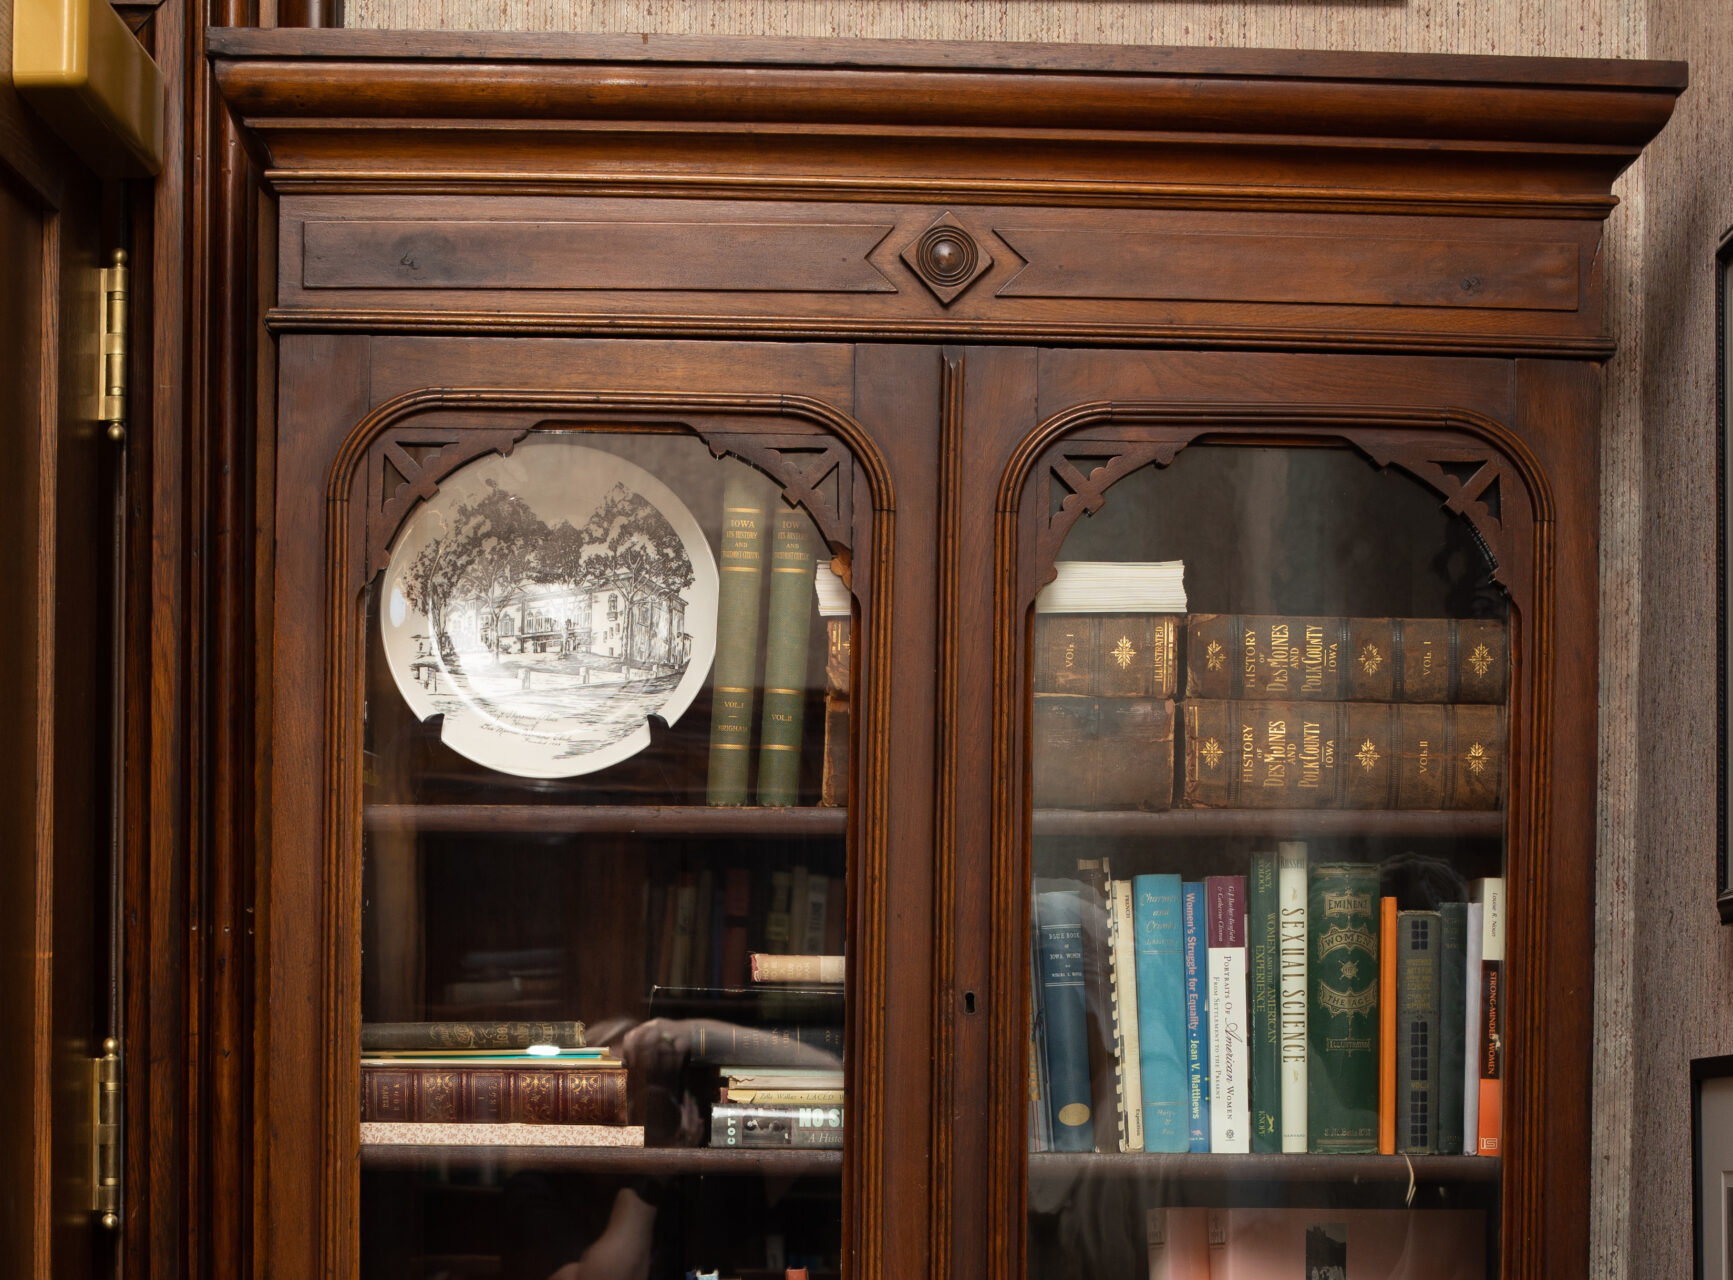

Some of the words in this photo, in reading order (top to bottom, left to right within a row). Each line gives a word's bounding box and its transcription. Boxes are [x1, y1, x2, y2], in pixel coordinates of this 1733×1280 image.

[730, 519, 755, 528] IOWA
[1154, 626, 1165, 682] ILLUSTRATED
[1245, 628, 1256, 689] HISTORY
[1267, 624, 1289, 668] MOINES
[1290, 647, 1299, 669] AND
[1302, 625, 1323, 664] COUNTY
[1328, 643, 1338, 672] IOWA
[1266, 669, 1288, 692] DES
[1301, 665, 1322, 692] POLK
[1243, 724, 1254, 783] HISTORY
[1257, 747, 1263, 758] OF
[1264, 720, 1286, 763] MOINES
[1287, 743, 1297, 766] AND
[1299, 721, 1320, 760] COUNTY
[1326, 740, 1335, 768] IOWA
[1263, 764, 1285, 787] DES
[1298, 761, 1320, 787] POLK
[1186, 893, 1196, 934] Women's
[1328, 899, 1368, 910] EMINENT
[1267, 912, 1276, 954] WOMEN
[1282, 908, 1305, 981] SEXUAL
[1324, 933, 1371, 947] WOMEN
[1187, 936, 1198, 975] Struggle
[1189, 977, 1198, 991] for
[1256, 945, 1265, 1012] EXPERIENCE
[1188, 993, 1200, 1030] Equality
[1267, 985, 1277, 1043] AMERICAN
[1328, 995, 1345, 1006] THE
[1351, 996, 1368, 1007] AGE
[1489, 970, 1498, 1039] STRONG-MINDED
[1282, 989, 1306, 1063] SCIENCE
[1190, 1040, 1200, 1060] Jean
[1225, 1017, 1243, 1082] American
[1487, 1042, 1496, 1075] WOMEN
[1191, 1063, 1201, 1071] V.
[1191, 1074, 1201, 1119] Matthews
[799, 1108, 824, 1127] NO
[808, 1134, 816, 1143] A
